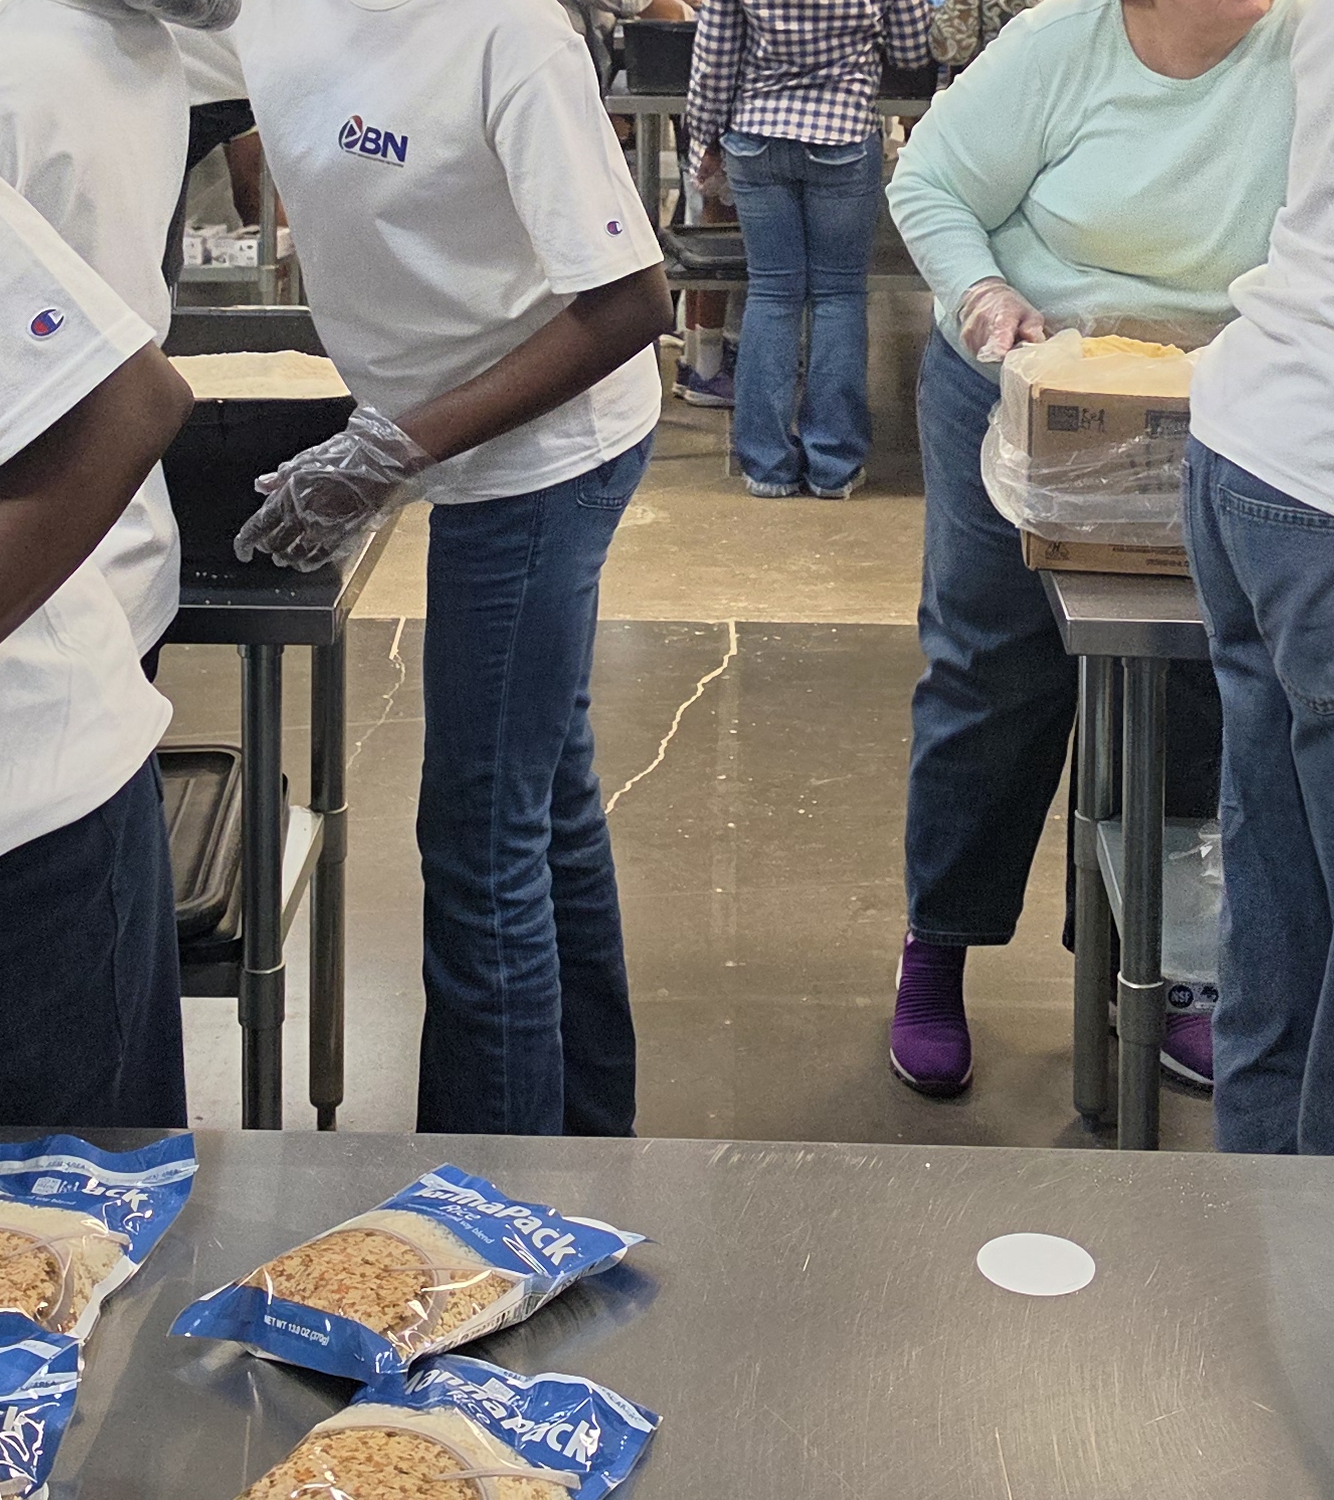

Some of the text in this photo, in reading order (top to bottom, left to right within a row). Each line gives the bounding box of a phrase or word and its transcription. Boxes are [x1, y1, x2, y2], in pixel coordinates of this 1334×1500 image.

[471, 1226, 495, 1244] blend
[264, 1315, 276, 1326] NET
[276, 1319, 287, 1329] WT
[300, 1327, 311, 1338] OZ
